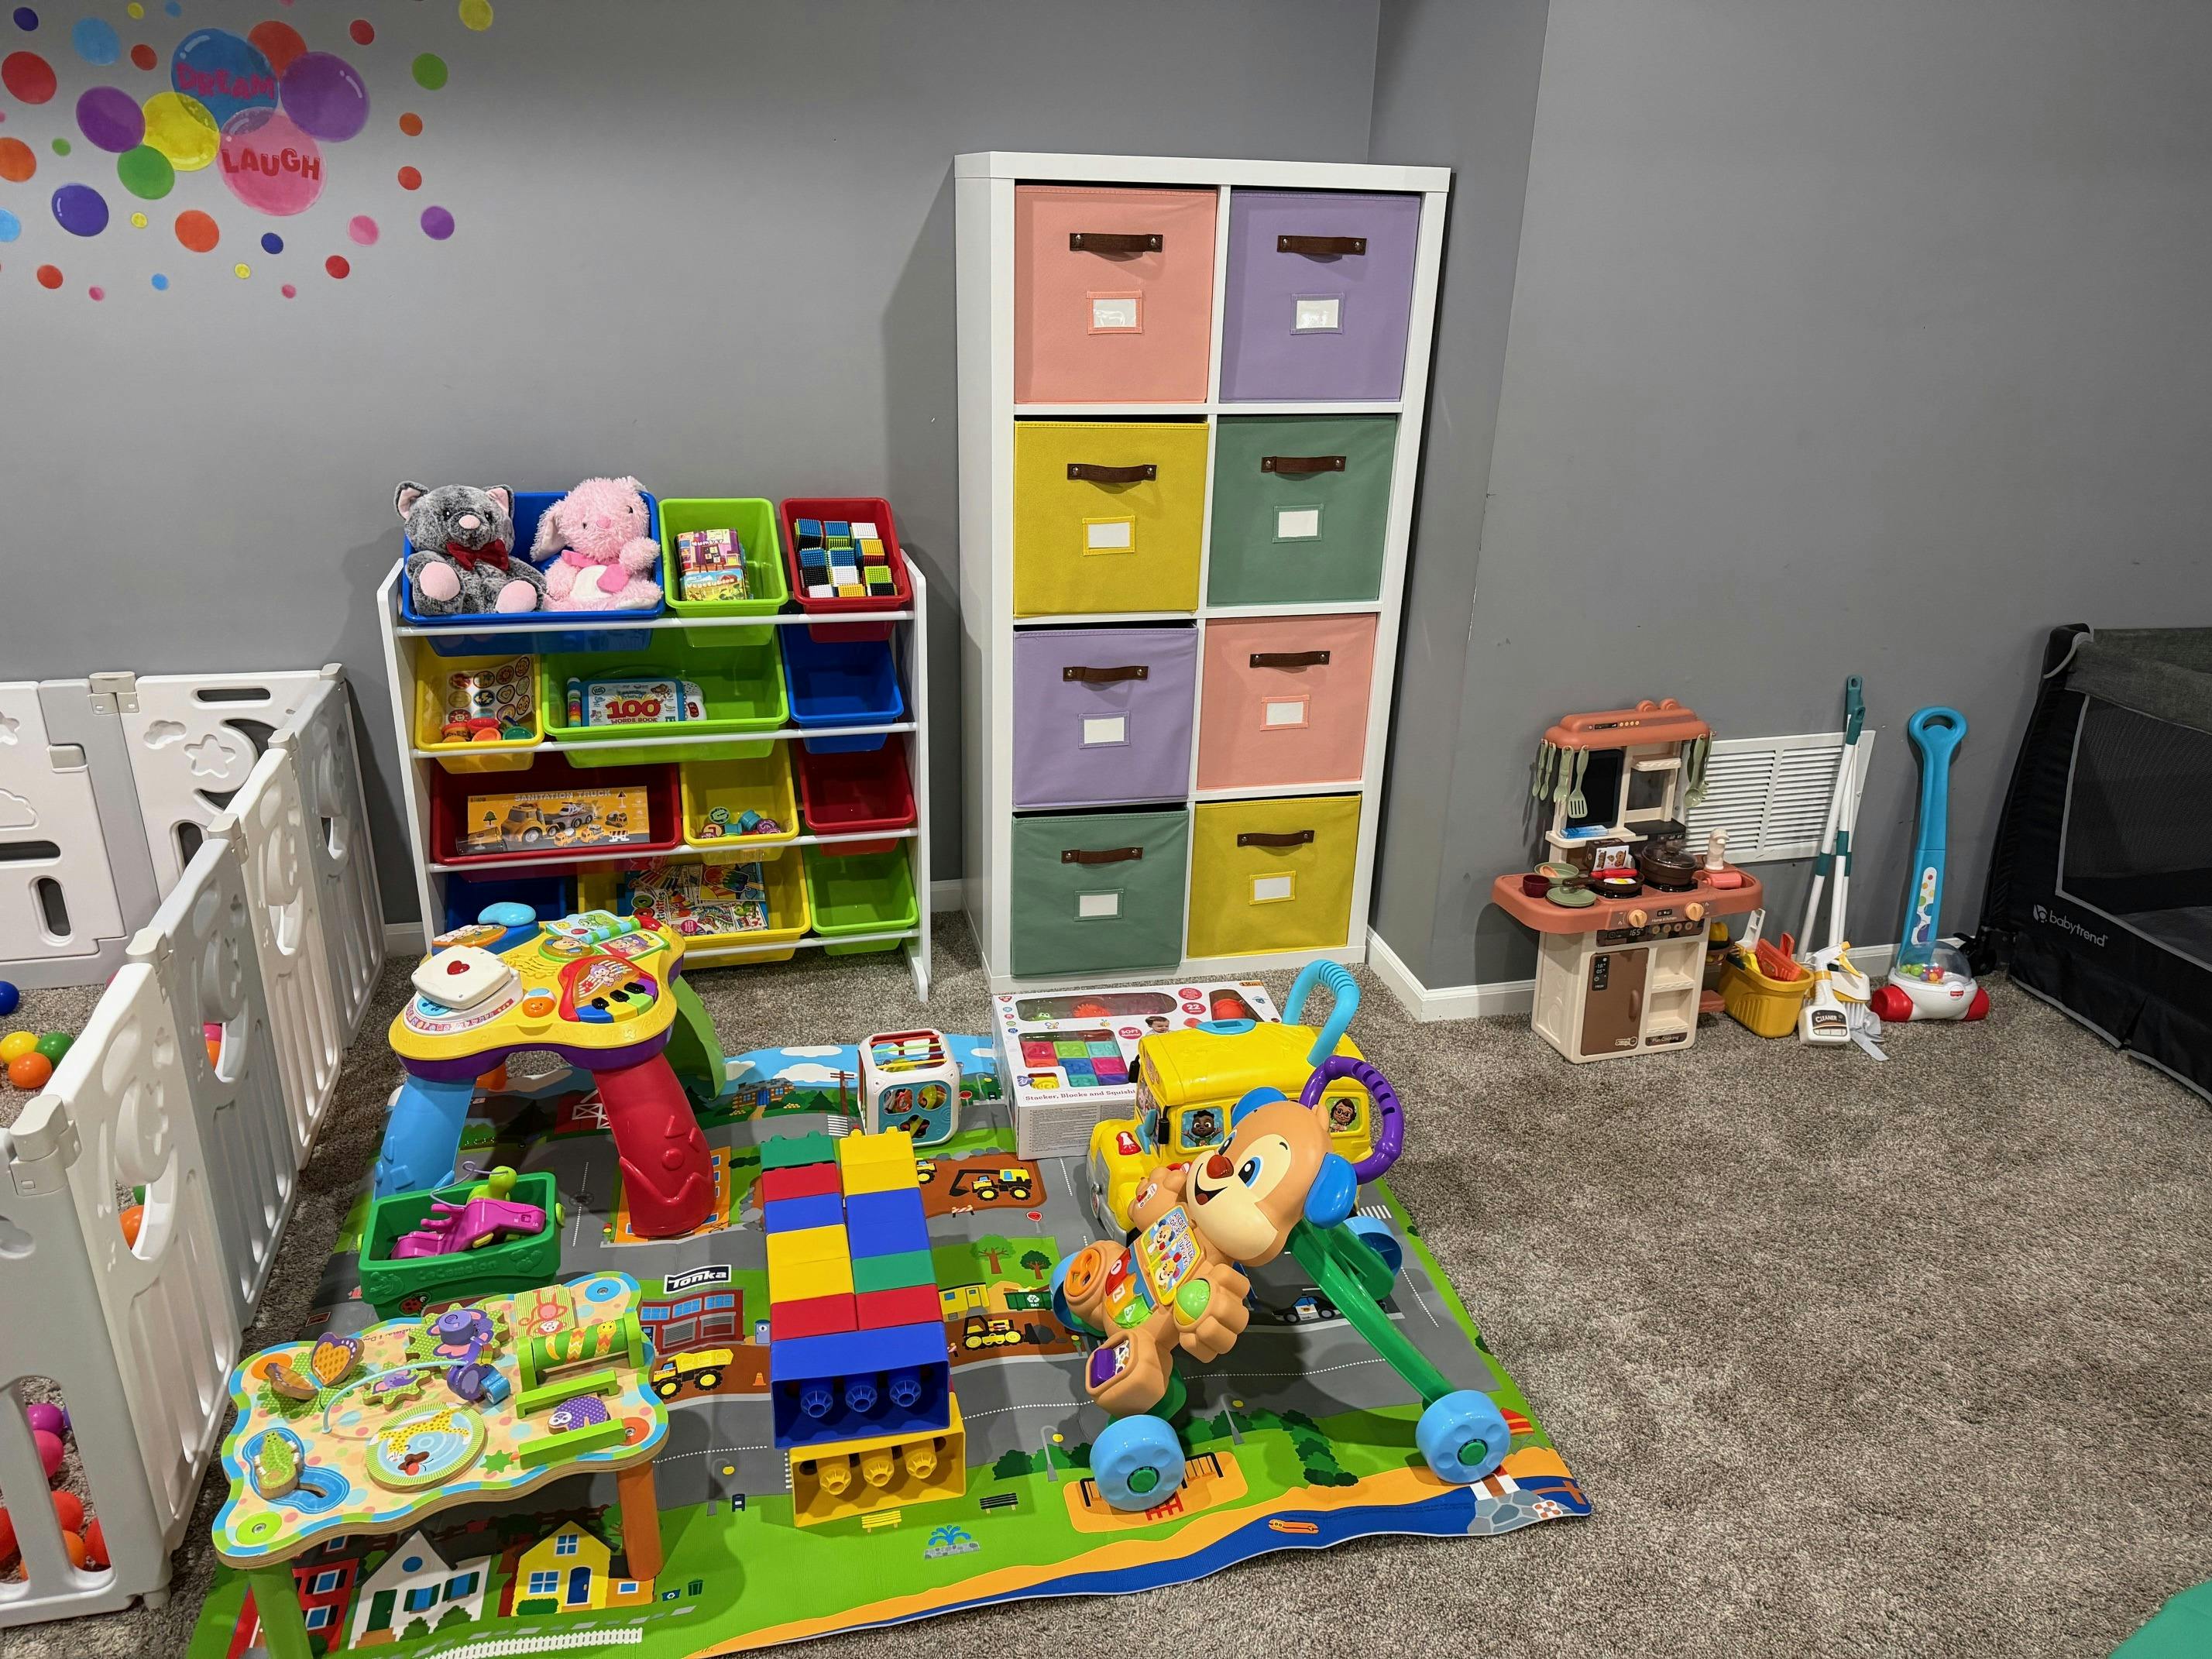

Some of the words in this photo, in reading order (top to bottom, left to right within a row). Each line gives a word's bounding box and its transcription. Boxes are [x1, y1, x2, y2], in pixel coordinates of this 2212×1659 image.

[177, 61, 275, 100] DREAM
[222, 147, 321, 180] LAUGH
[605, 699, 661, 720] 100
[514, 792, 574, 802] SANITATION
[578, 789, 612, 798] TRUCK
[656, 891, 666, 924] ctivities
[2049, 909, 2106, 947] babytrend
[1112, 1262, 1121, 1272] 1
[668, 1270, 726, 1289] Tonka
[1113, 1286, 1124, 1299] 2
[1125, 1306, 1134, 1316] 3
